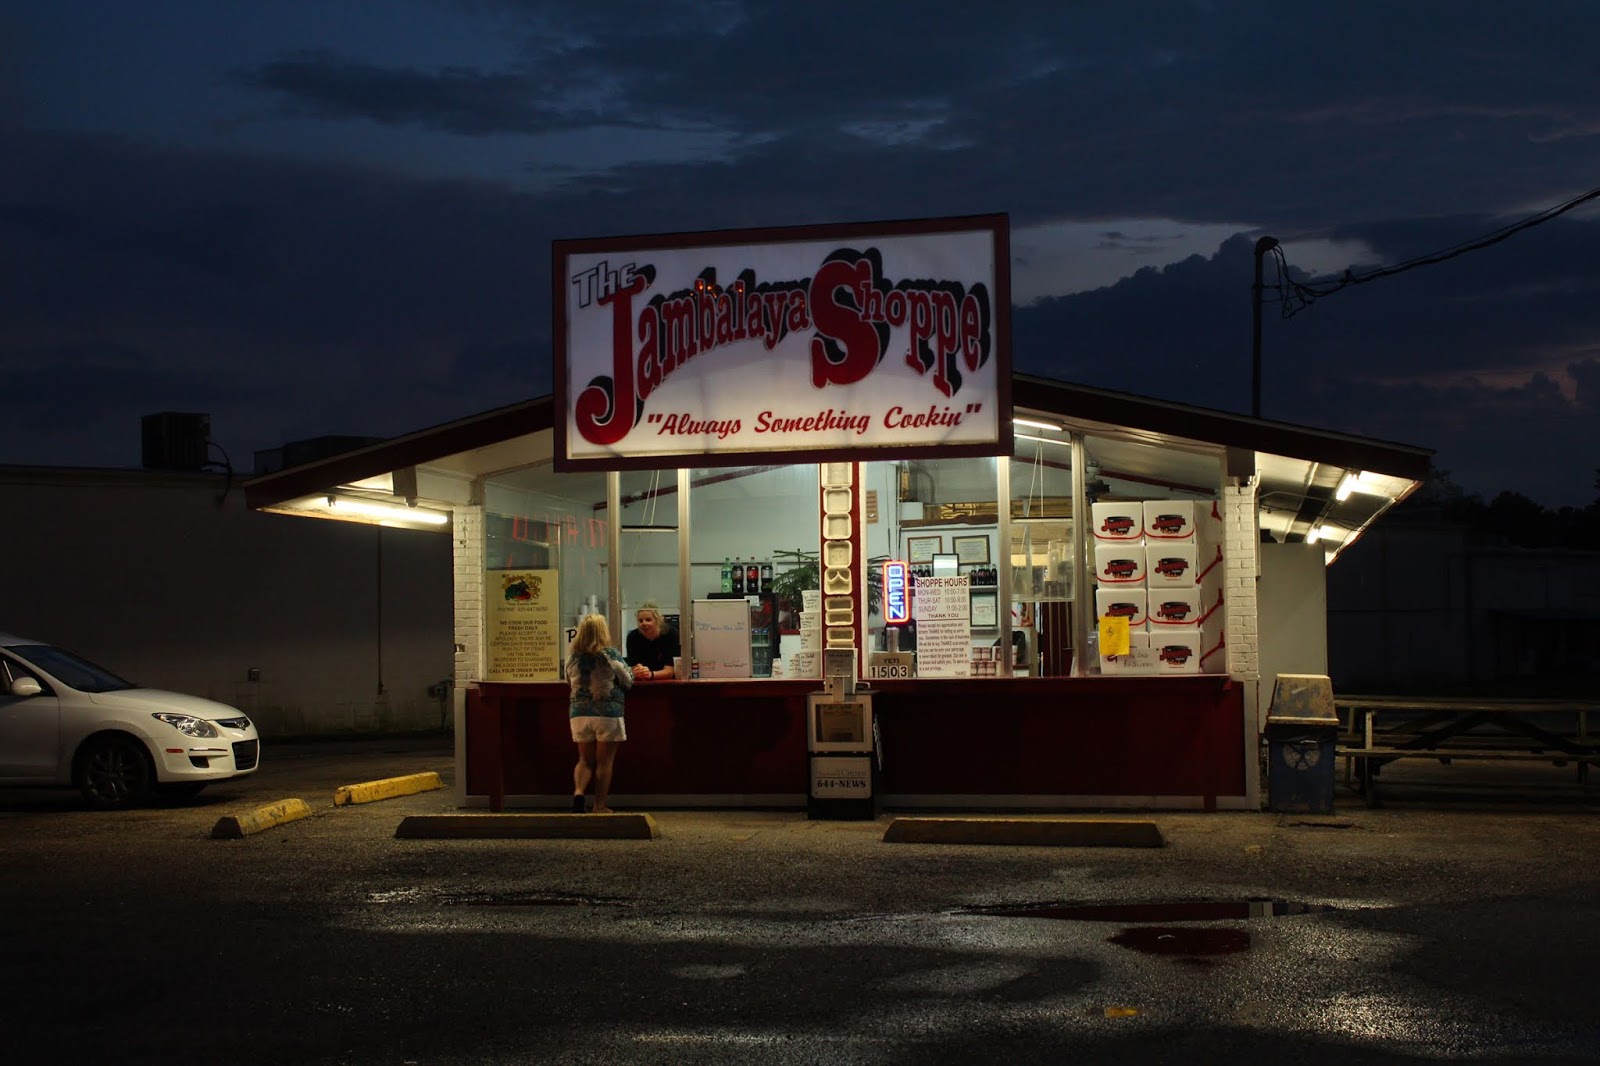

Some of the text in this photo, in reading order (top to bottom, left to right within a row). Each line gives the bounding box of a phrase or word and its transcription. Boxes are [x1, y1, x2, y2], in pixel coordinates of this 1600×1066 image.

[575, 247, 990, 445] Jambalaya Shoppe
[647, 403, 982, 440] "Always Something Cookin"
[888, 565, 905, 619] OPEN
[916, 578, 968, 588] SHOPPE HOURS
[871, 666, 907, 678] 1503
[817, 780, 866, 788] 644-NEWS
